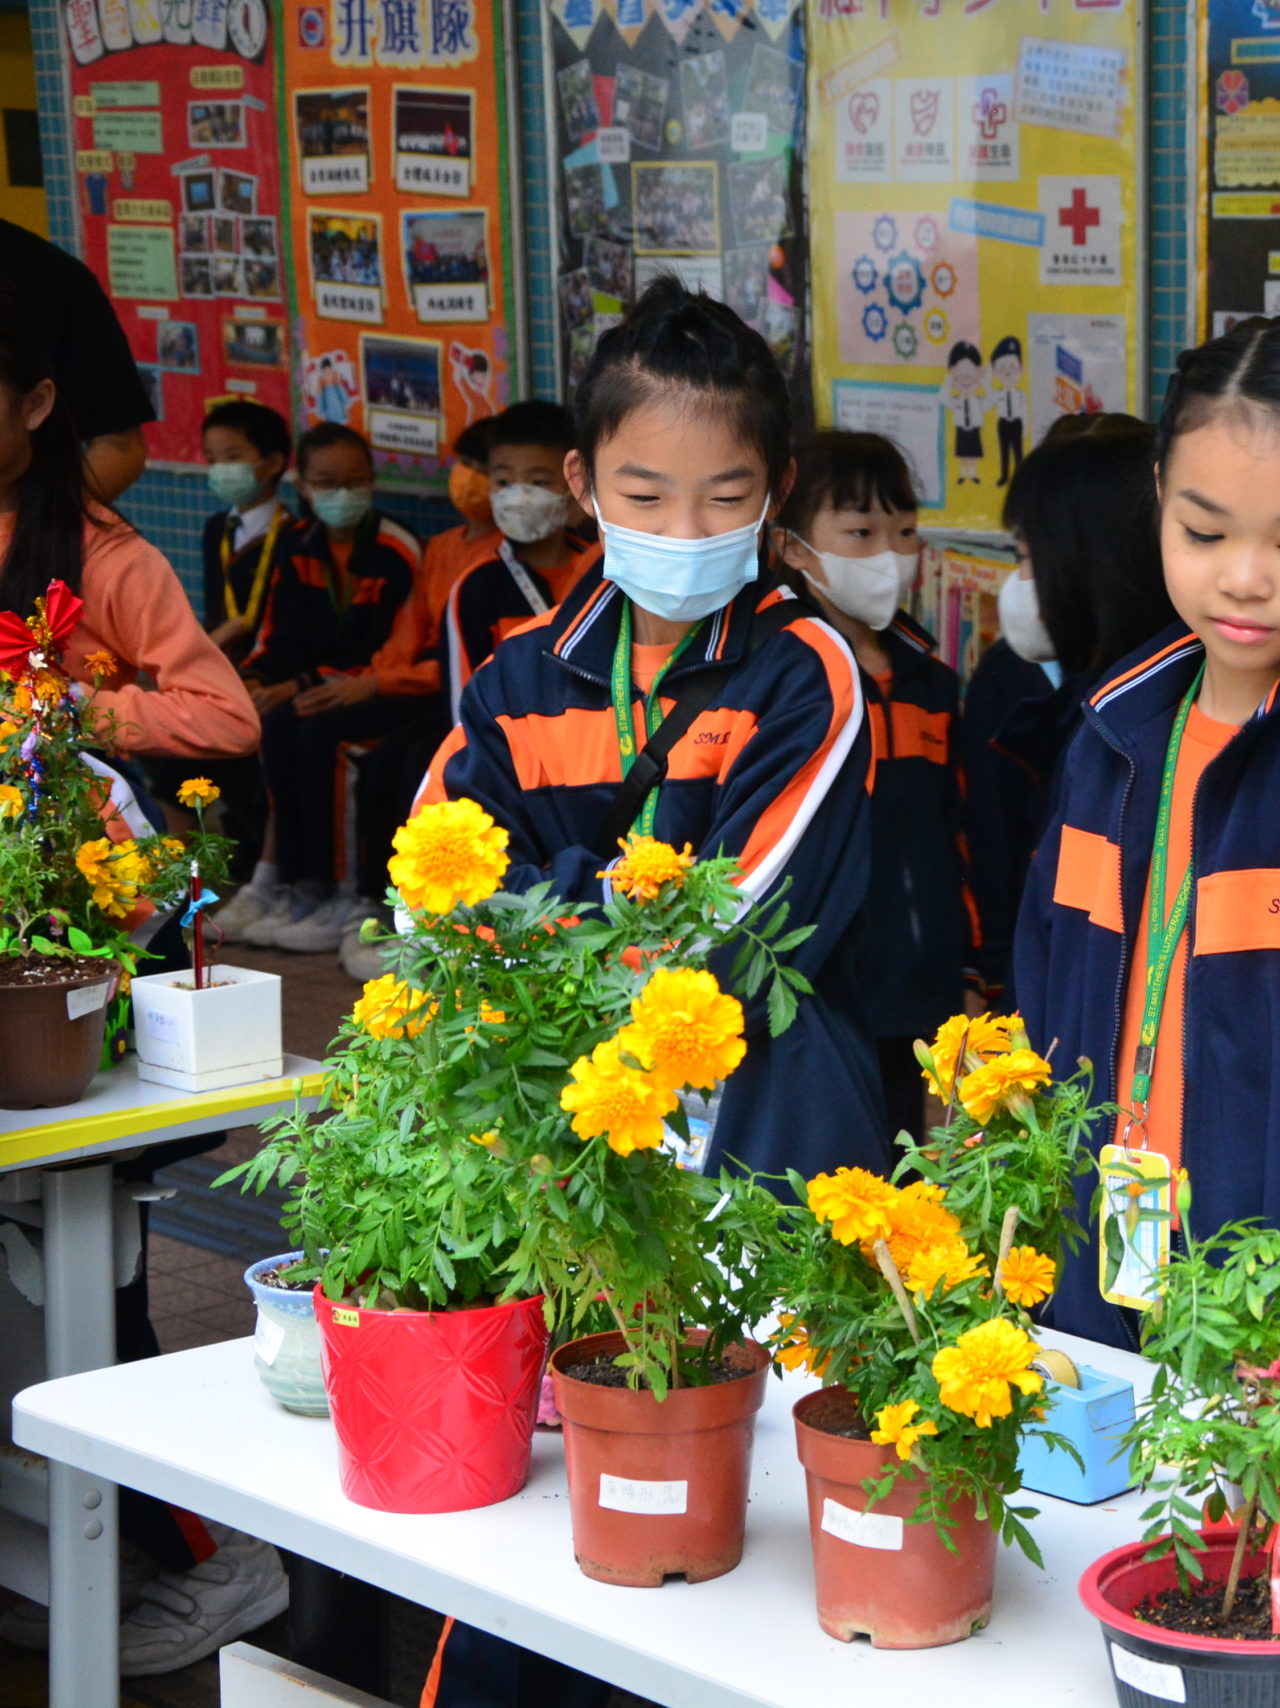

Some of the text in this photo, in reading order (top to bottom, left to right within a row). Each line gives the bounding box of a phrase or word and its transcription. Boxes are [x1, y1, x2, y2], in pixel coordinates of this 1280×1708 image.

[338, 0, 471, 55] 升旗隊
[1163, 907, 1183, 954] LUTHERAN
